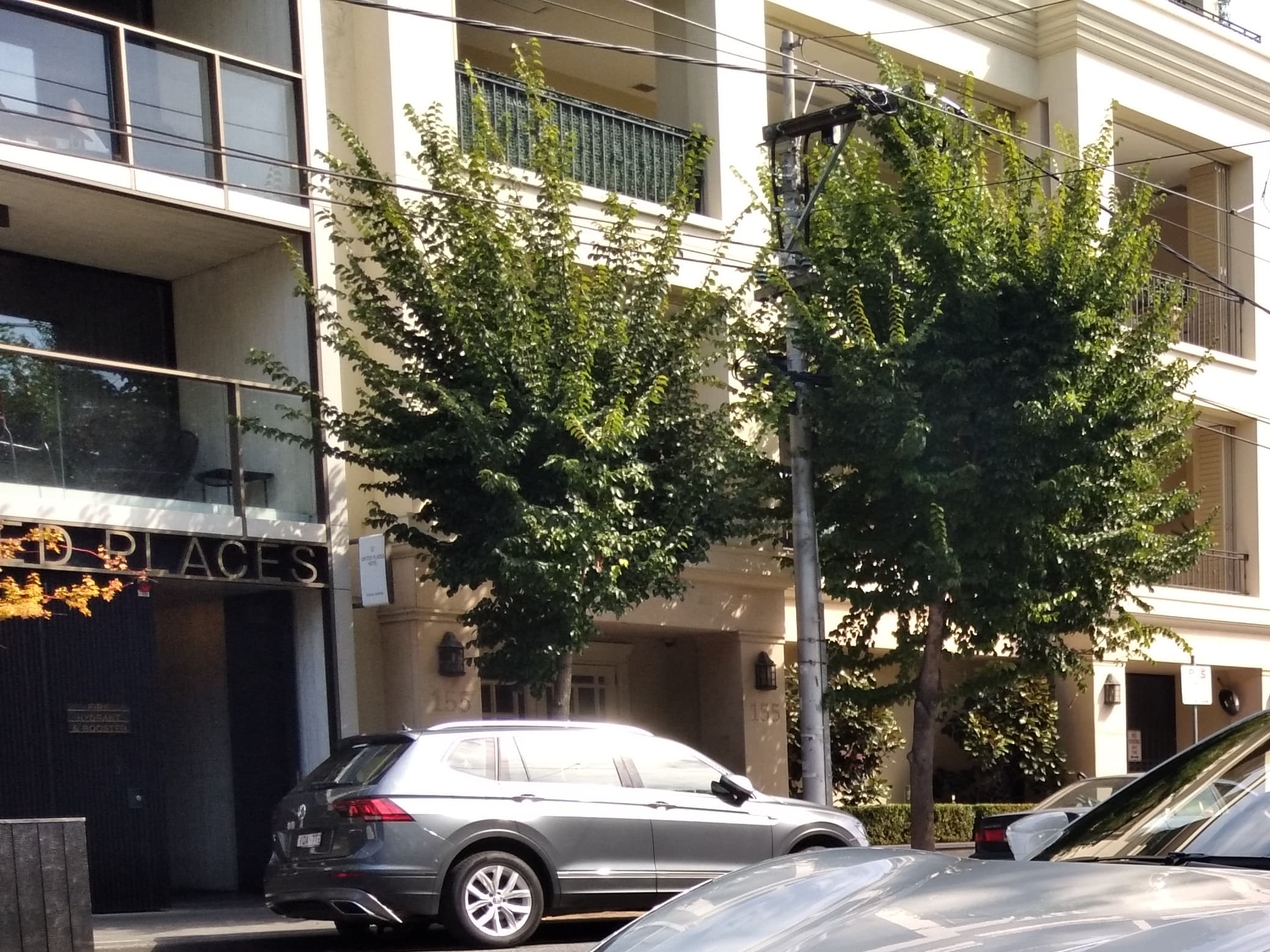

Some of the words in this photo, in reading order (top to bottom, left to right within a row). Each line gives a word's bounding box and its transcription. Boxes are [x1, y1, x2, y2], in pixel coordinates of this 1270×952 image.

[105, 529, 318, 584] PLACES
[432, 690, 471, 712] 155
[751, 702, 781, 722] 155
